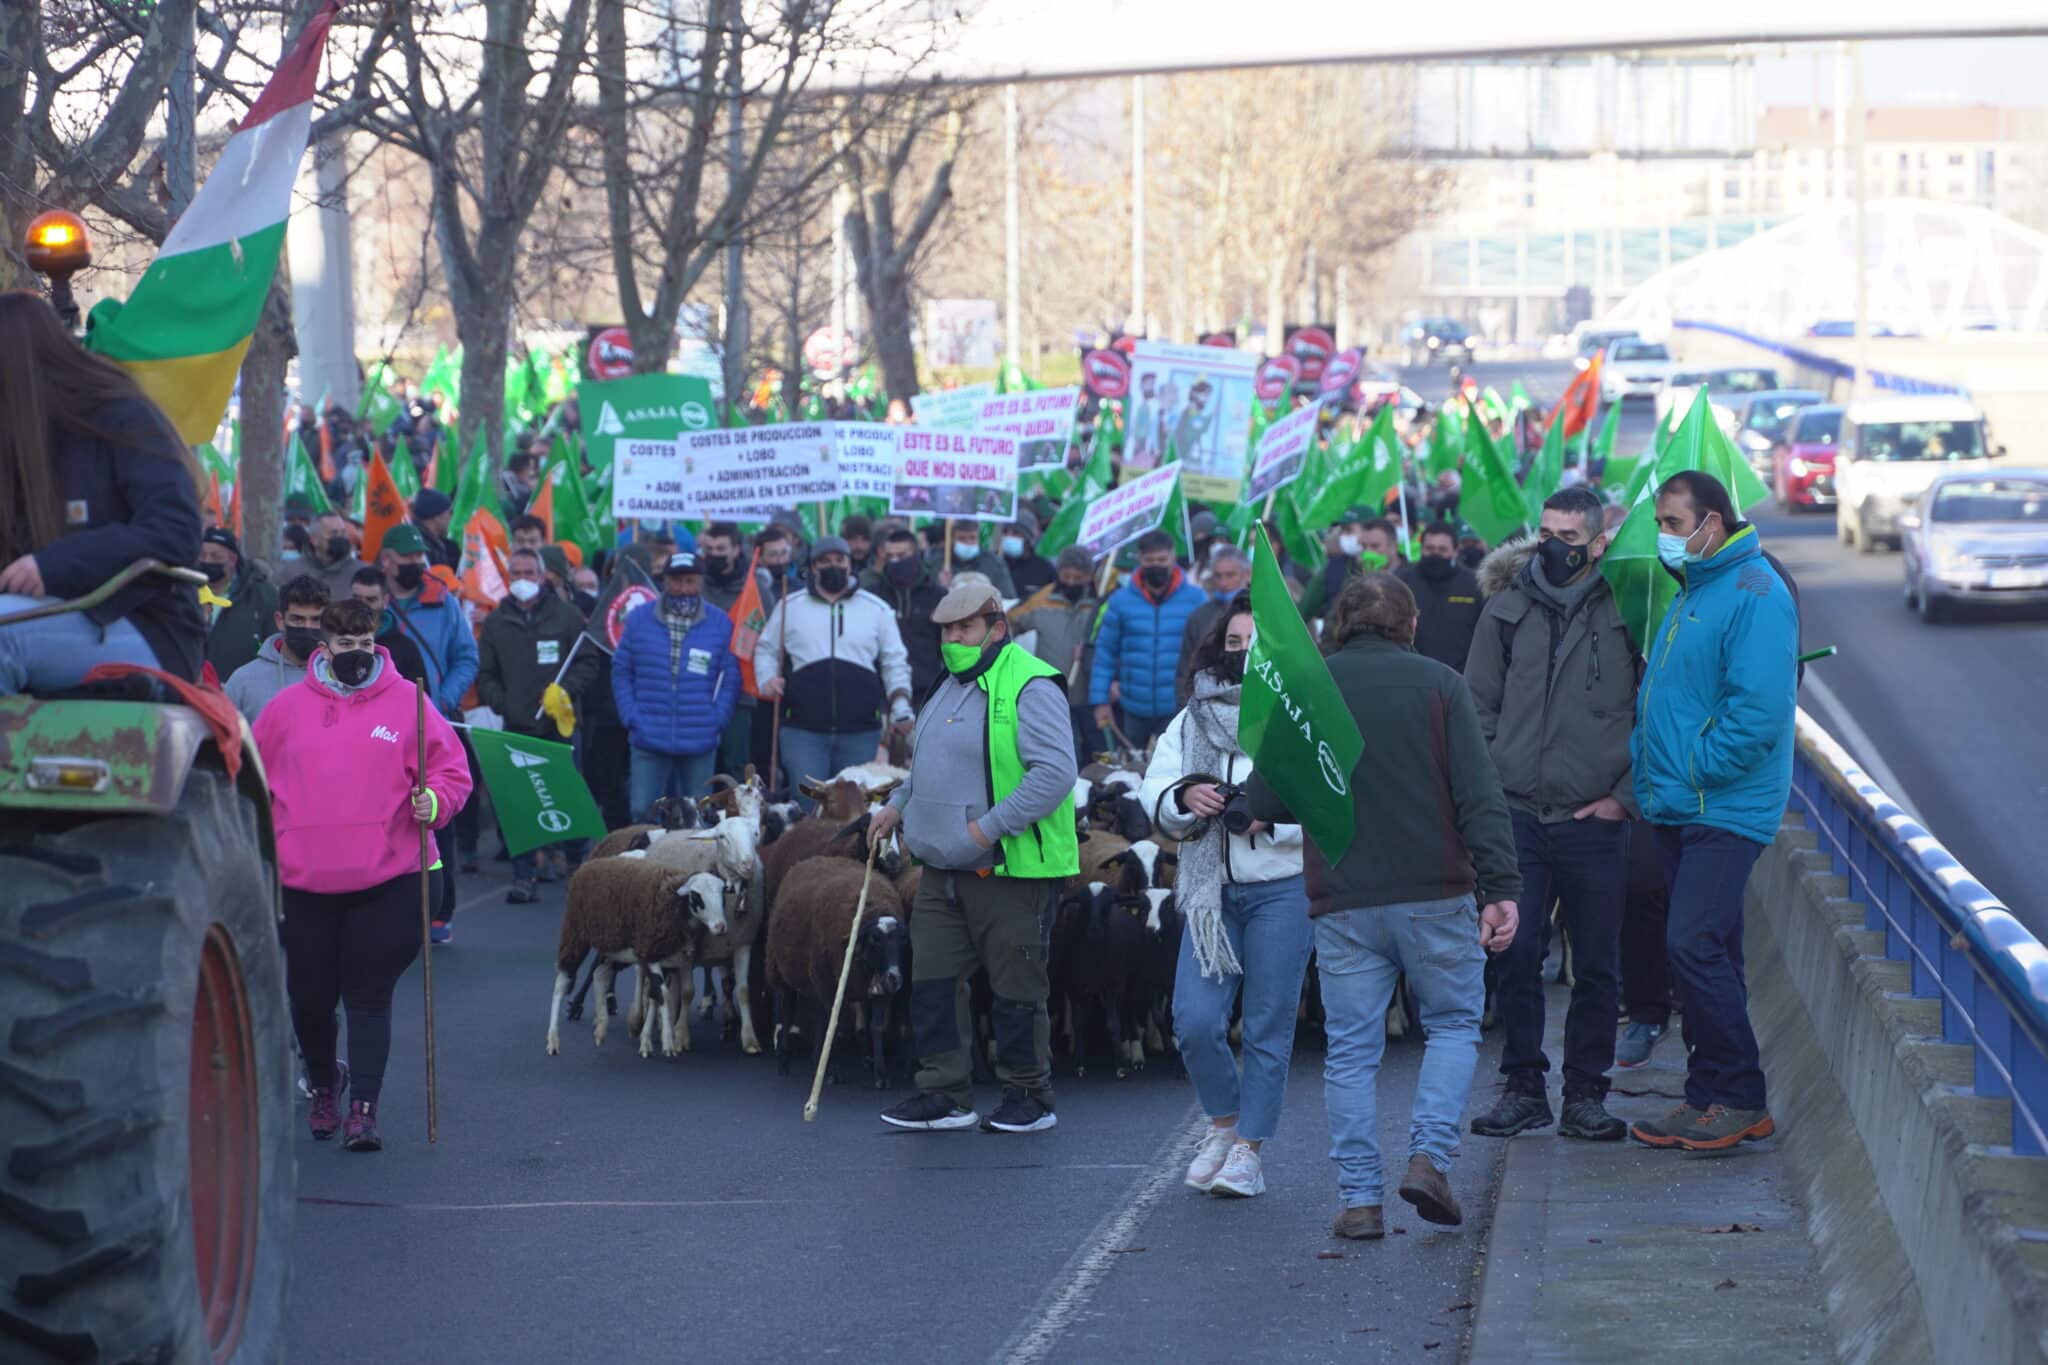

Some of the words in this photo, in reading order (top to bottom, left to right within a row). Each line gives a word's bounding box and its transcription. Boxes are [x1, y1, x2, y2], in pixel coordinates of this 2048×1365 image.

[690, 433, 731, 448] COSTES
[734, 431, 748, 444] DE
[904, 432, 931, 450] ESTE
[935, 434, 949, 452] ES
[953, 436, 966, 453] EL
[970, 437, 1013, 455] FUTURO
[630, 444, 676, 457] COSTES
[746, 448, 776, 461] LOBO
[905, 460, 929, 477] QUE
[933, 461, 955, 478] NOS
[960, 463, 997, 480] QUEDA
[759, 485, 774, 498] EN
[1254, 660, 1313, 744] ASAJA
